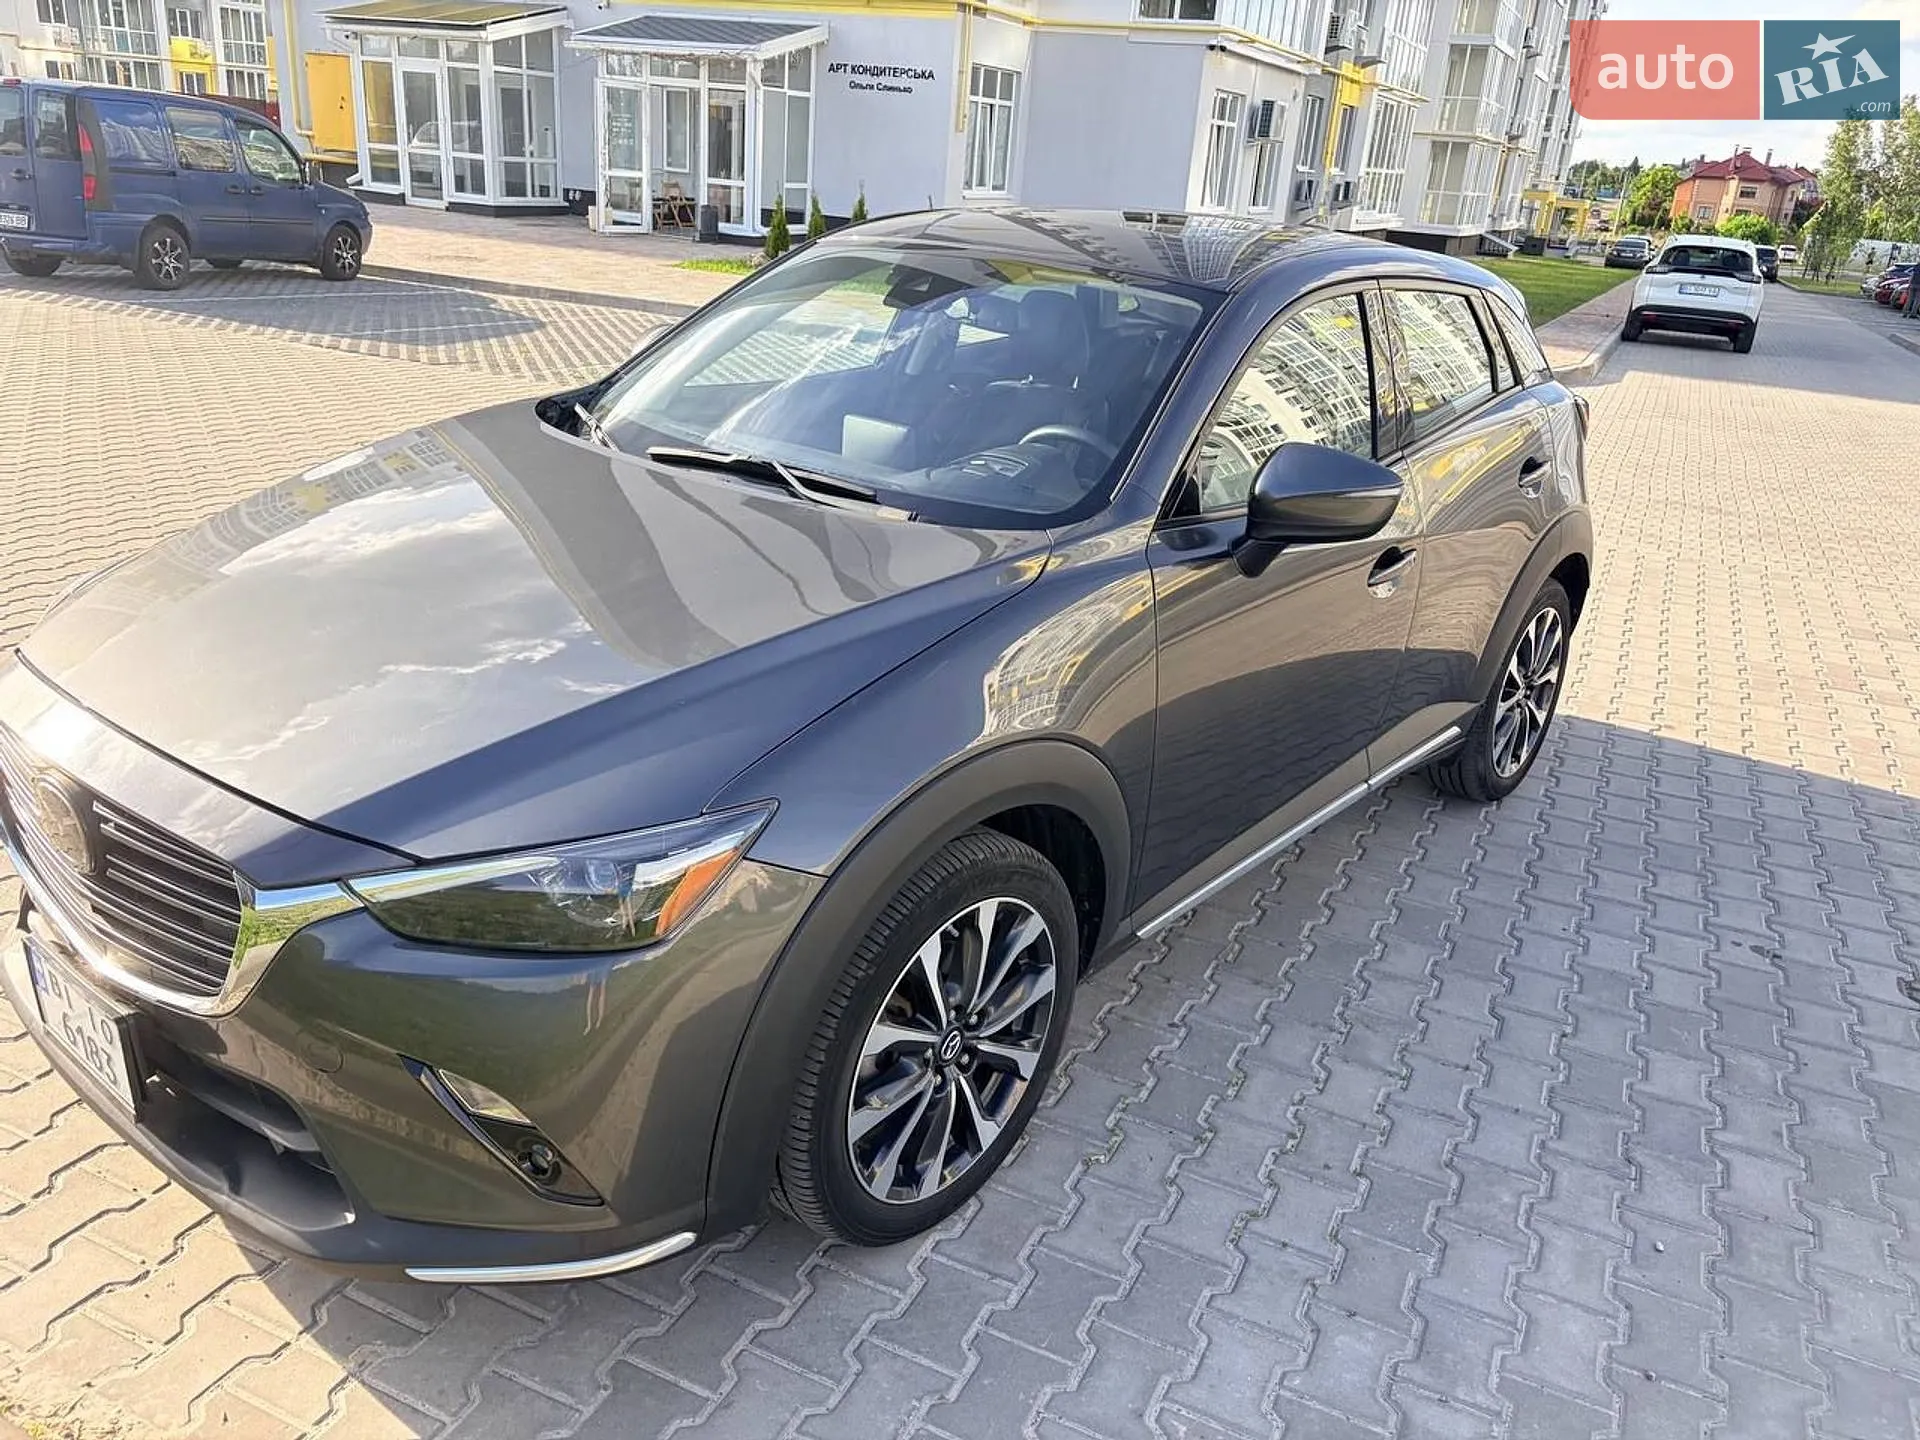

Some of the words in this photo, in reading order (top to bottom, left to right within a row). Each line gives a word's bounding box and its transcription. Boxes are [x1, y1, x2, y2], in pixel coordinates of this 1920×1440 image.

[828, 62, 848, 74] АРТ
[850, 64, 936, 81] КОНДИТЕРСЬКА
[62, 1012, 117, 1085] 6183
